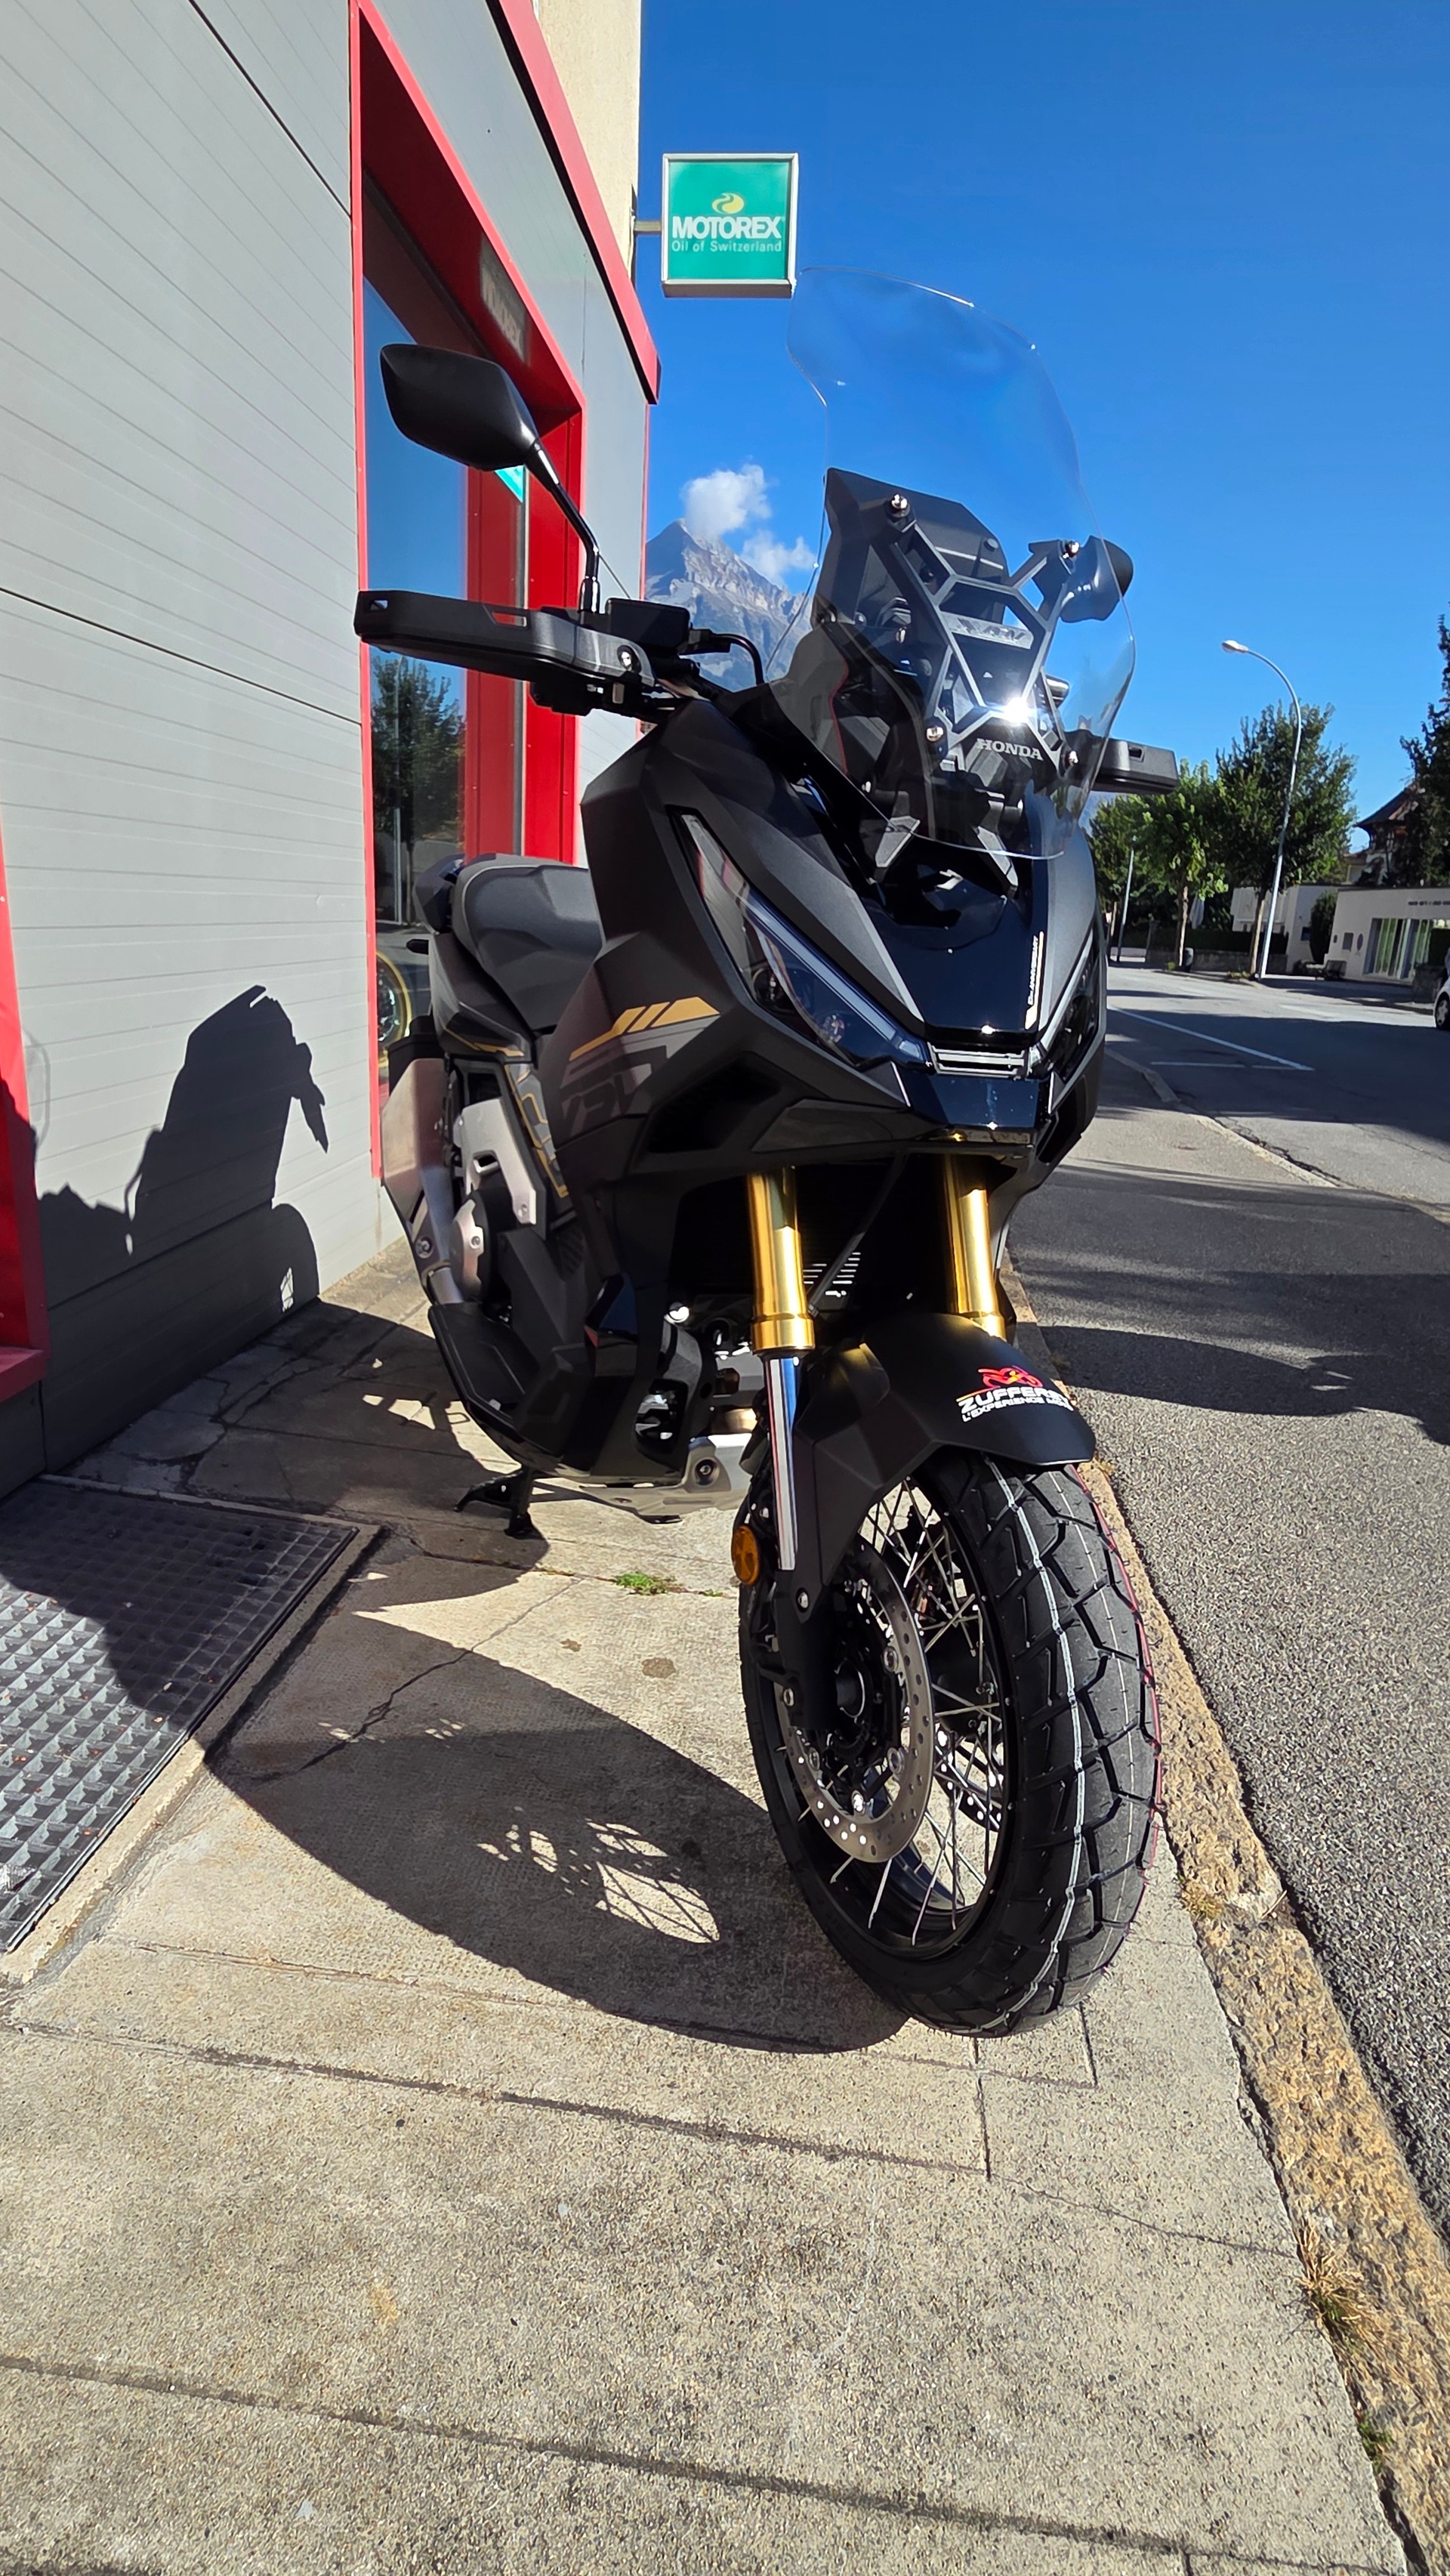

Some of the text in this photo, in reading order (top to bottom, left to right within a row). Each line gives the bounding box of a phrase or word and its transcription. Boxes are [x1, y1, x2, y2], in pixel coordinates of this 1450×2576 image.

[671, 216, 782, 239] MOTOREX
[671, 240, 782, 252] Oil of Switzerland
[976, 737, 1044, 761] HONDA
[958, 1386, 1074, 1415] ZUFFEREY
[961, 1397, 1045, 1422] L'EXPERIENCE
